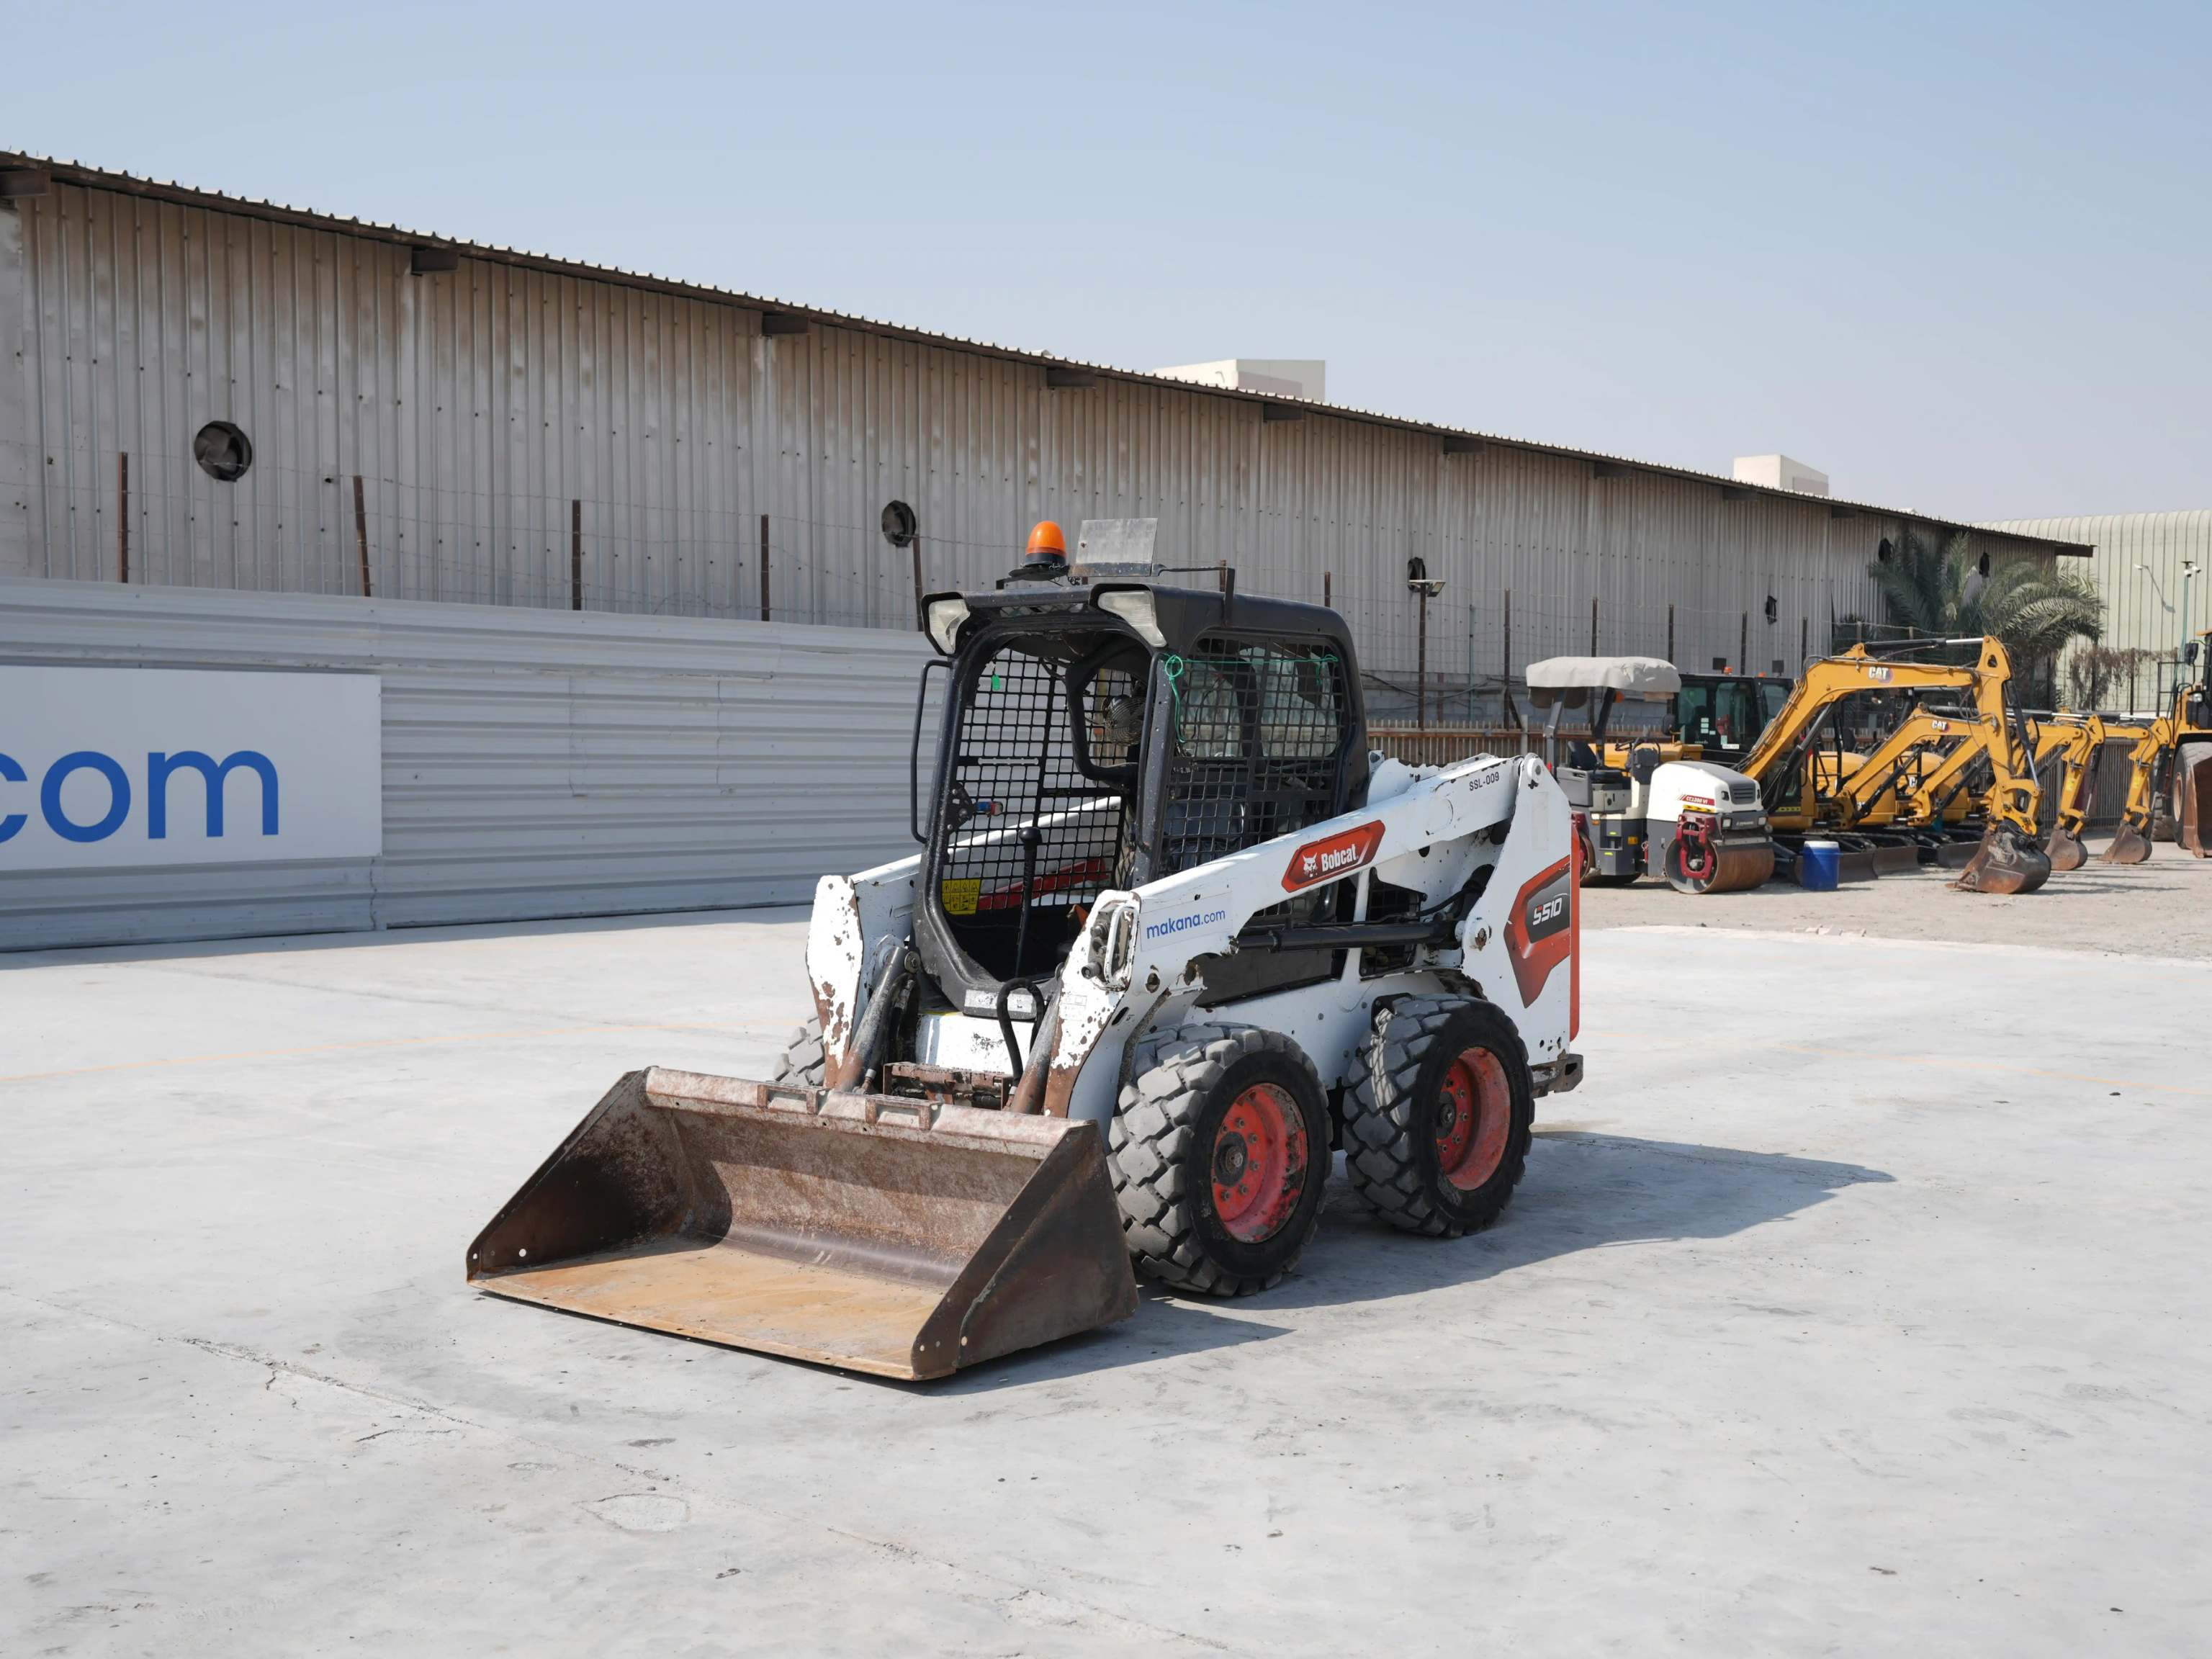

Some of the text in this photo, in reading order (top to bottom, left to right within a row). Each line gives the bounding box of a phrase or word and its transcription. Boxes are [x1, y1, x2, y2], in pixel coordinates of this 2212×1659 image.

[1868, 666, 1889, 680] CAT
[1931, 720, 1947, 731] CAT
[1469, 771, 1500, 791] SSL-009
[1321, 843, 1357, 872] Bobcat
[1532, 897, 1563, 926] S510
[1146, 910, 1226, 939] makana.com
